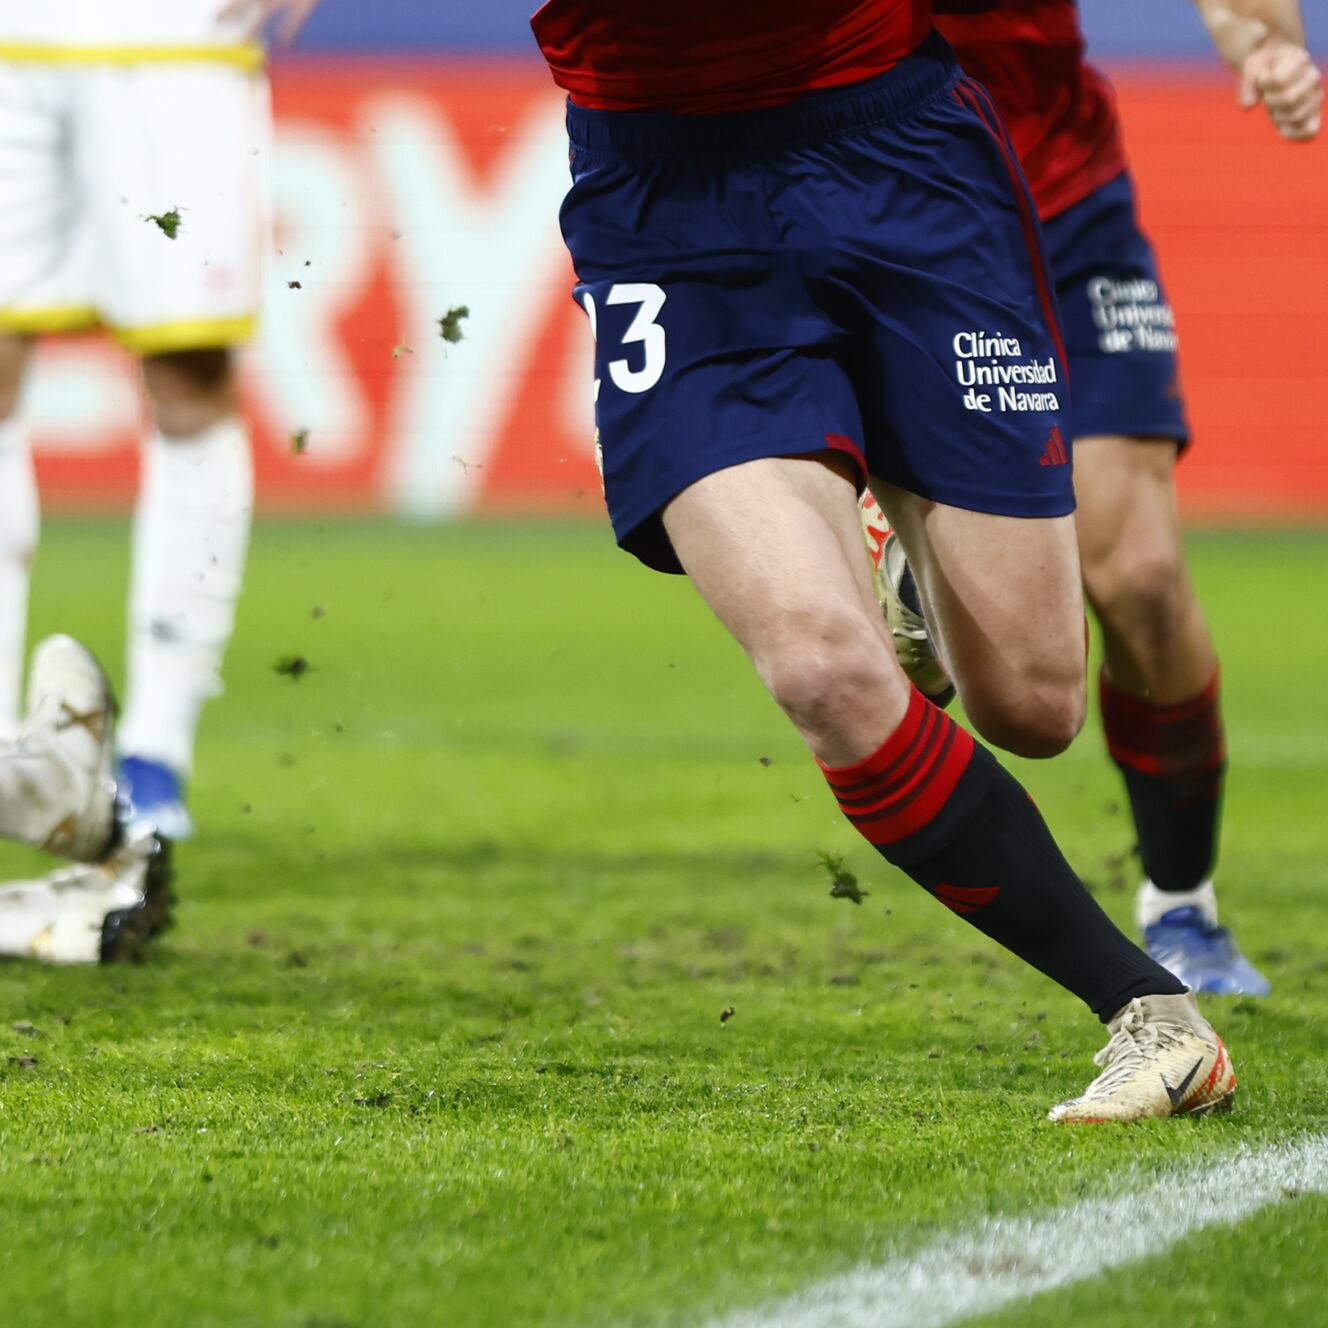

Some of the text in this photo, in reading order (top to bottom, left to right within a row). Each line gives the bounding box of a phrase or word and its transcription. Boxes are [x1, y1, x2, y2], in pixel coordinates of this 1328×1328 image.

[582, 282, 667, 404] 3
[953, 331, 1022, 359] Clínica
[963, 386, 1060, 412] de Navarra
